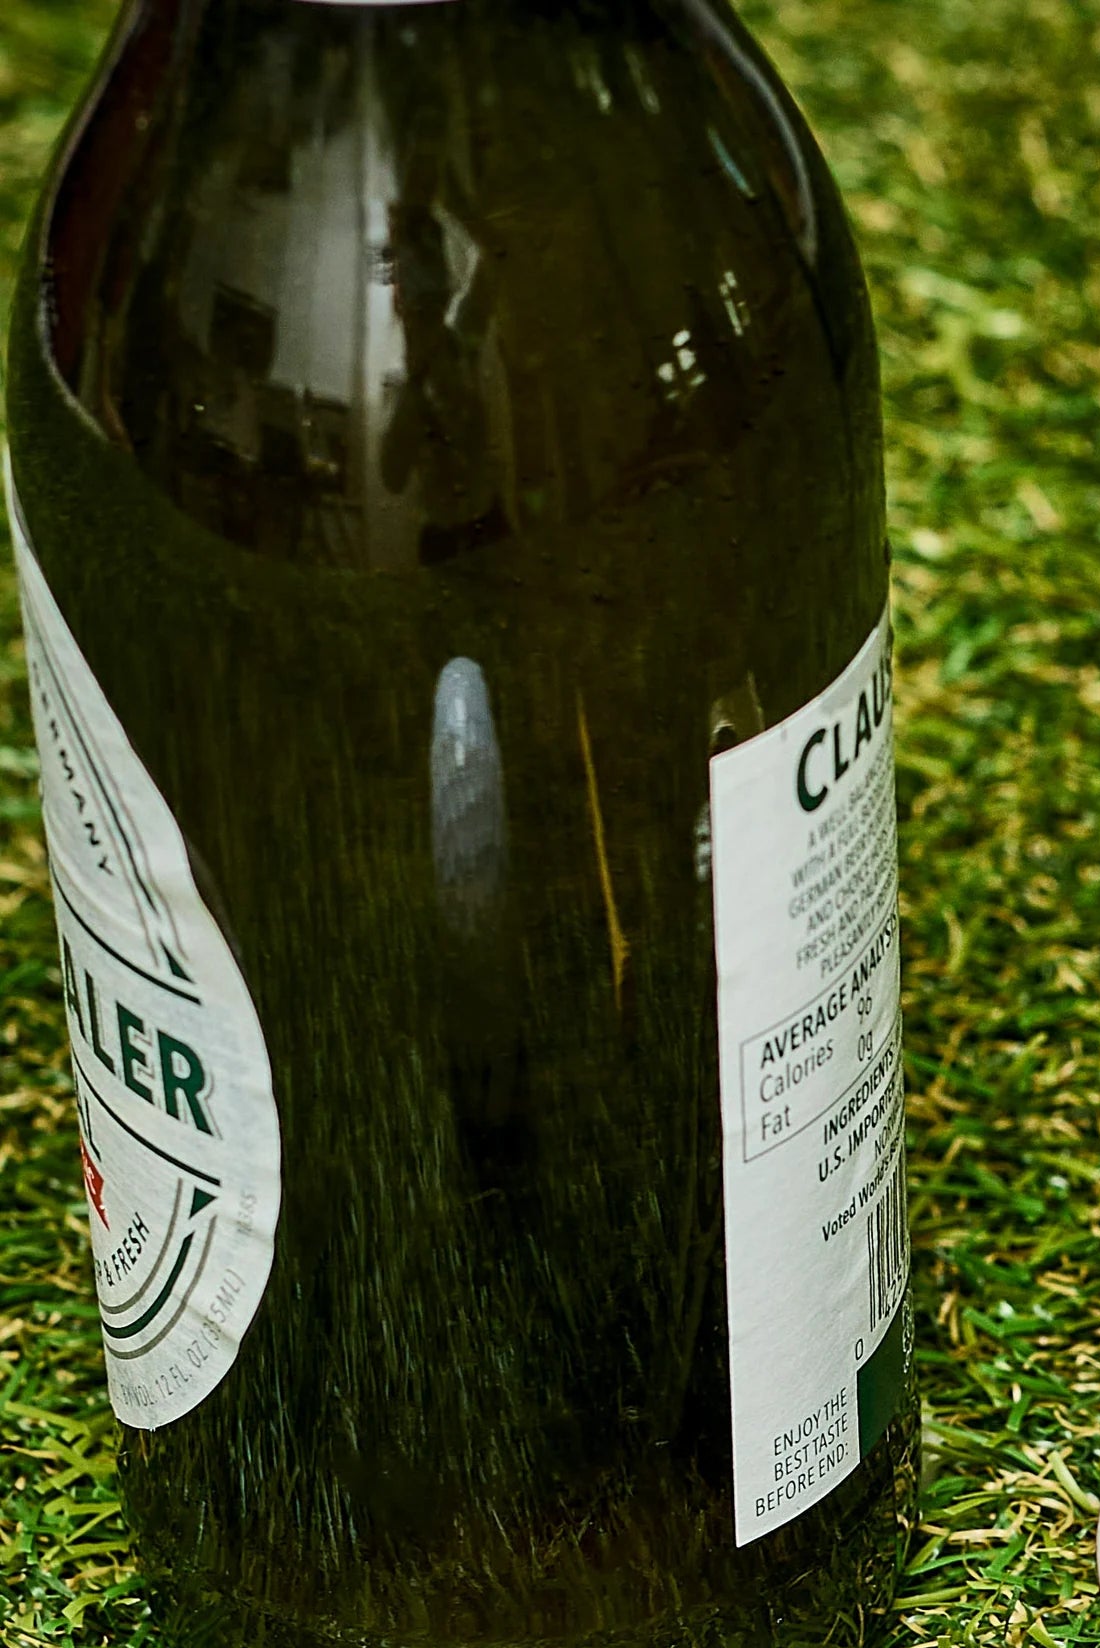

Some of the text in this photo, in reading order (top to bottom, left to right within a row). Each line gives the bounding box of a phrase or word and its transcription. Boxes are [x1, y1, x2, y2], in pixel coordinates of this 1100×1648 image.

[761, 982, 847, 1069] AVERAGE
[759, 1038, 834, 1103] Calories
[761, 1031, 873, 1141] Fat 0g
[818, 1145, 845, 1182] U.S.
[112, 1211, 150, 1281] FRESH
[822, 1196, 856, 1242] Voted
[774, 1387, 847, 1456] ENJOY THE
[774, 1412, 848, 1482] BEST TASTE
[755, 1441, 849, 1517] BEFORE END:
